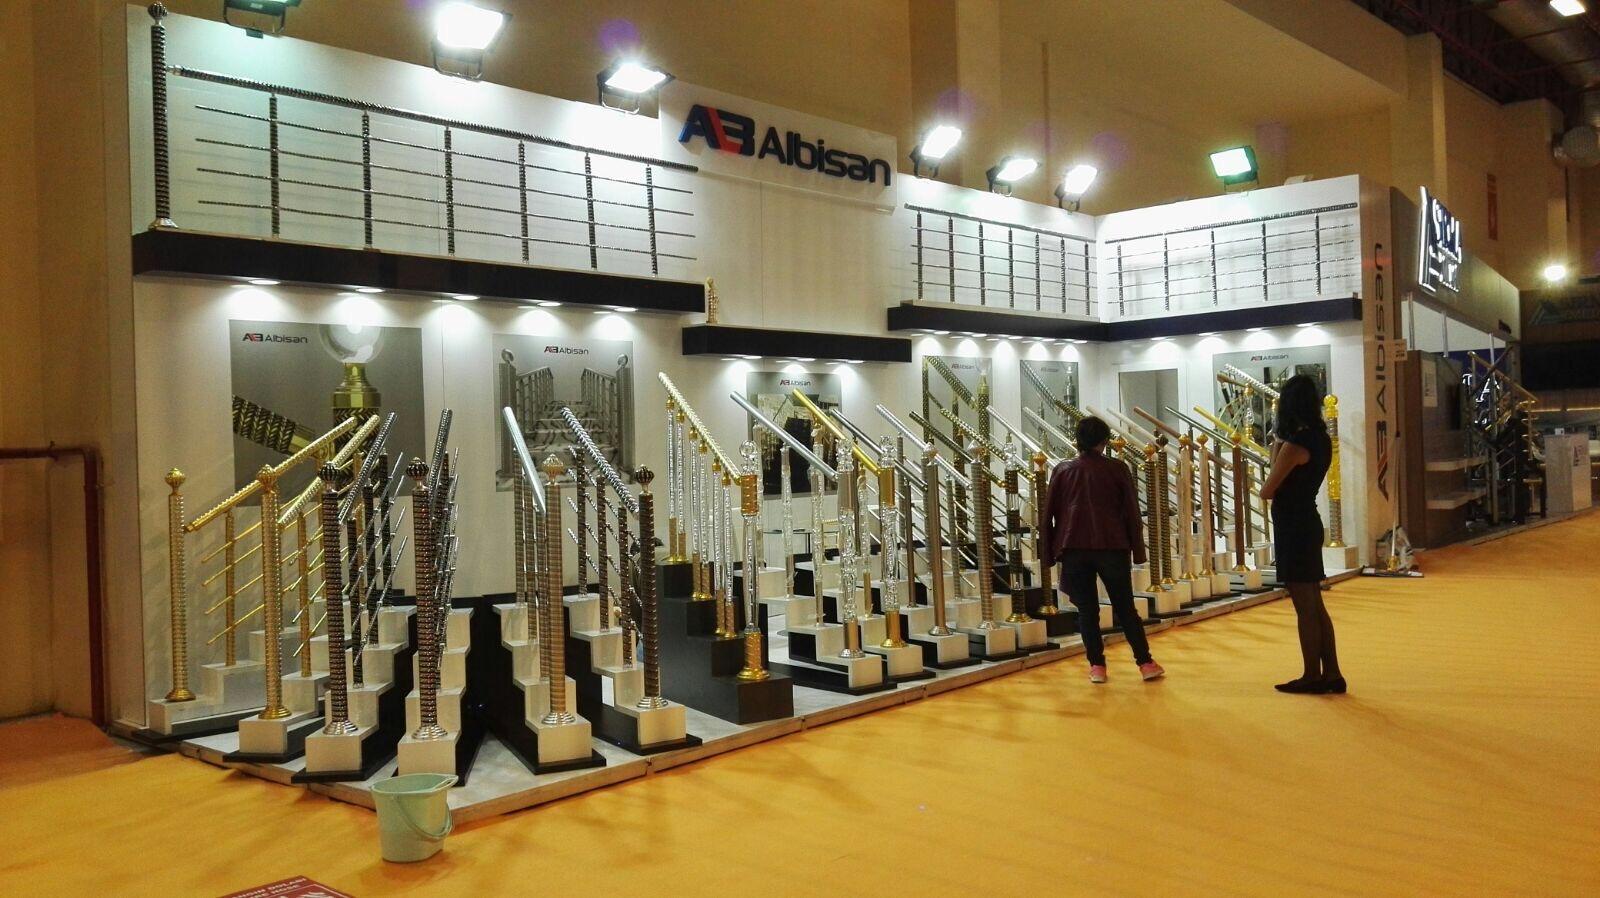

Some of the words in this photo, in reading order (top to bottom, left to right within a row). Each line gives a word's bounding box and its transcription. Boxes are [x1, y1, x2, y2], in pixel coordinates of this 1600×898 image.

[758, 126, 891, 187] Albisan
[264, 334, 308, 344] Albisan
[1375, 242, 1387, 414] Albisan
[559, 347, 589, 355] Albisan
